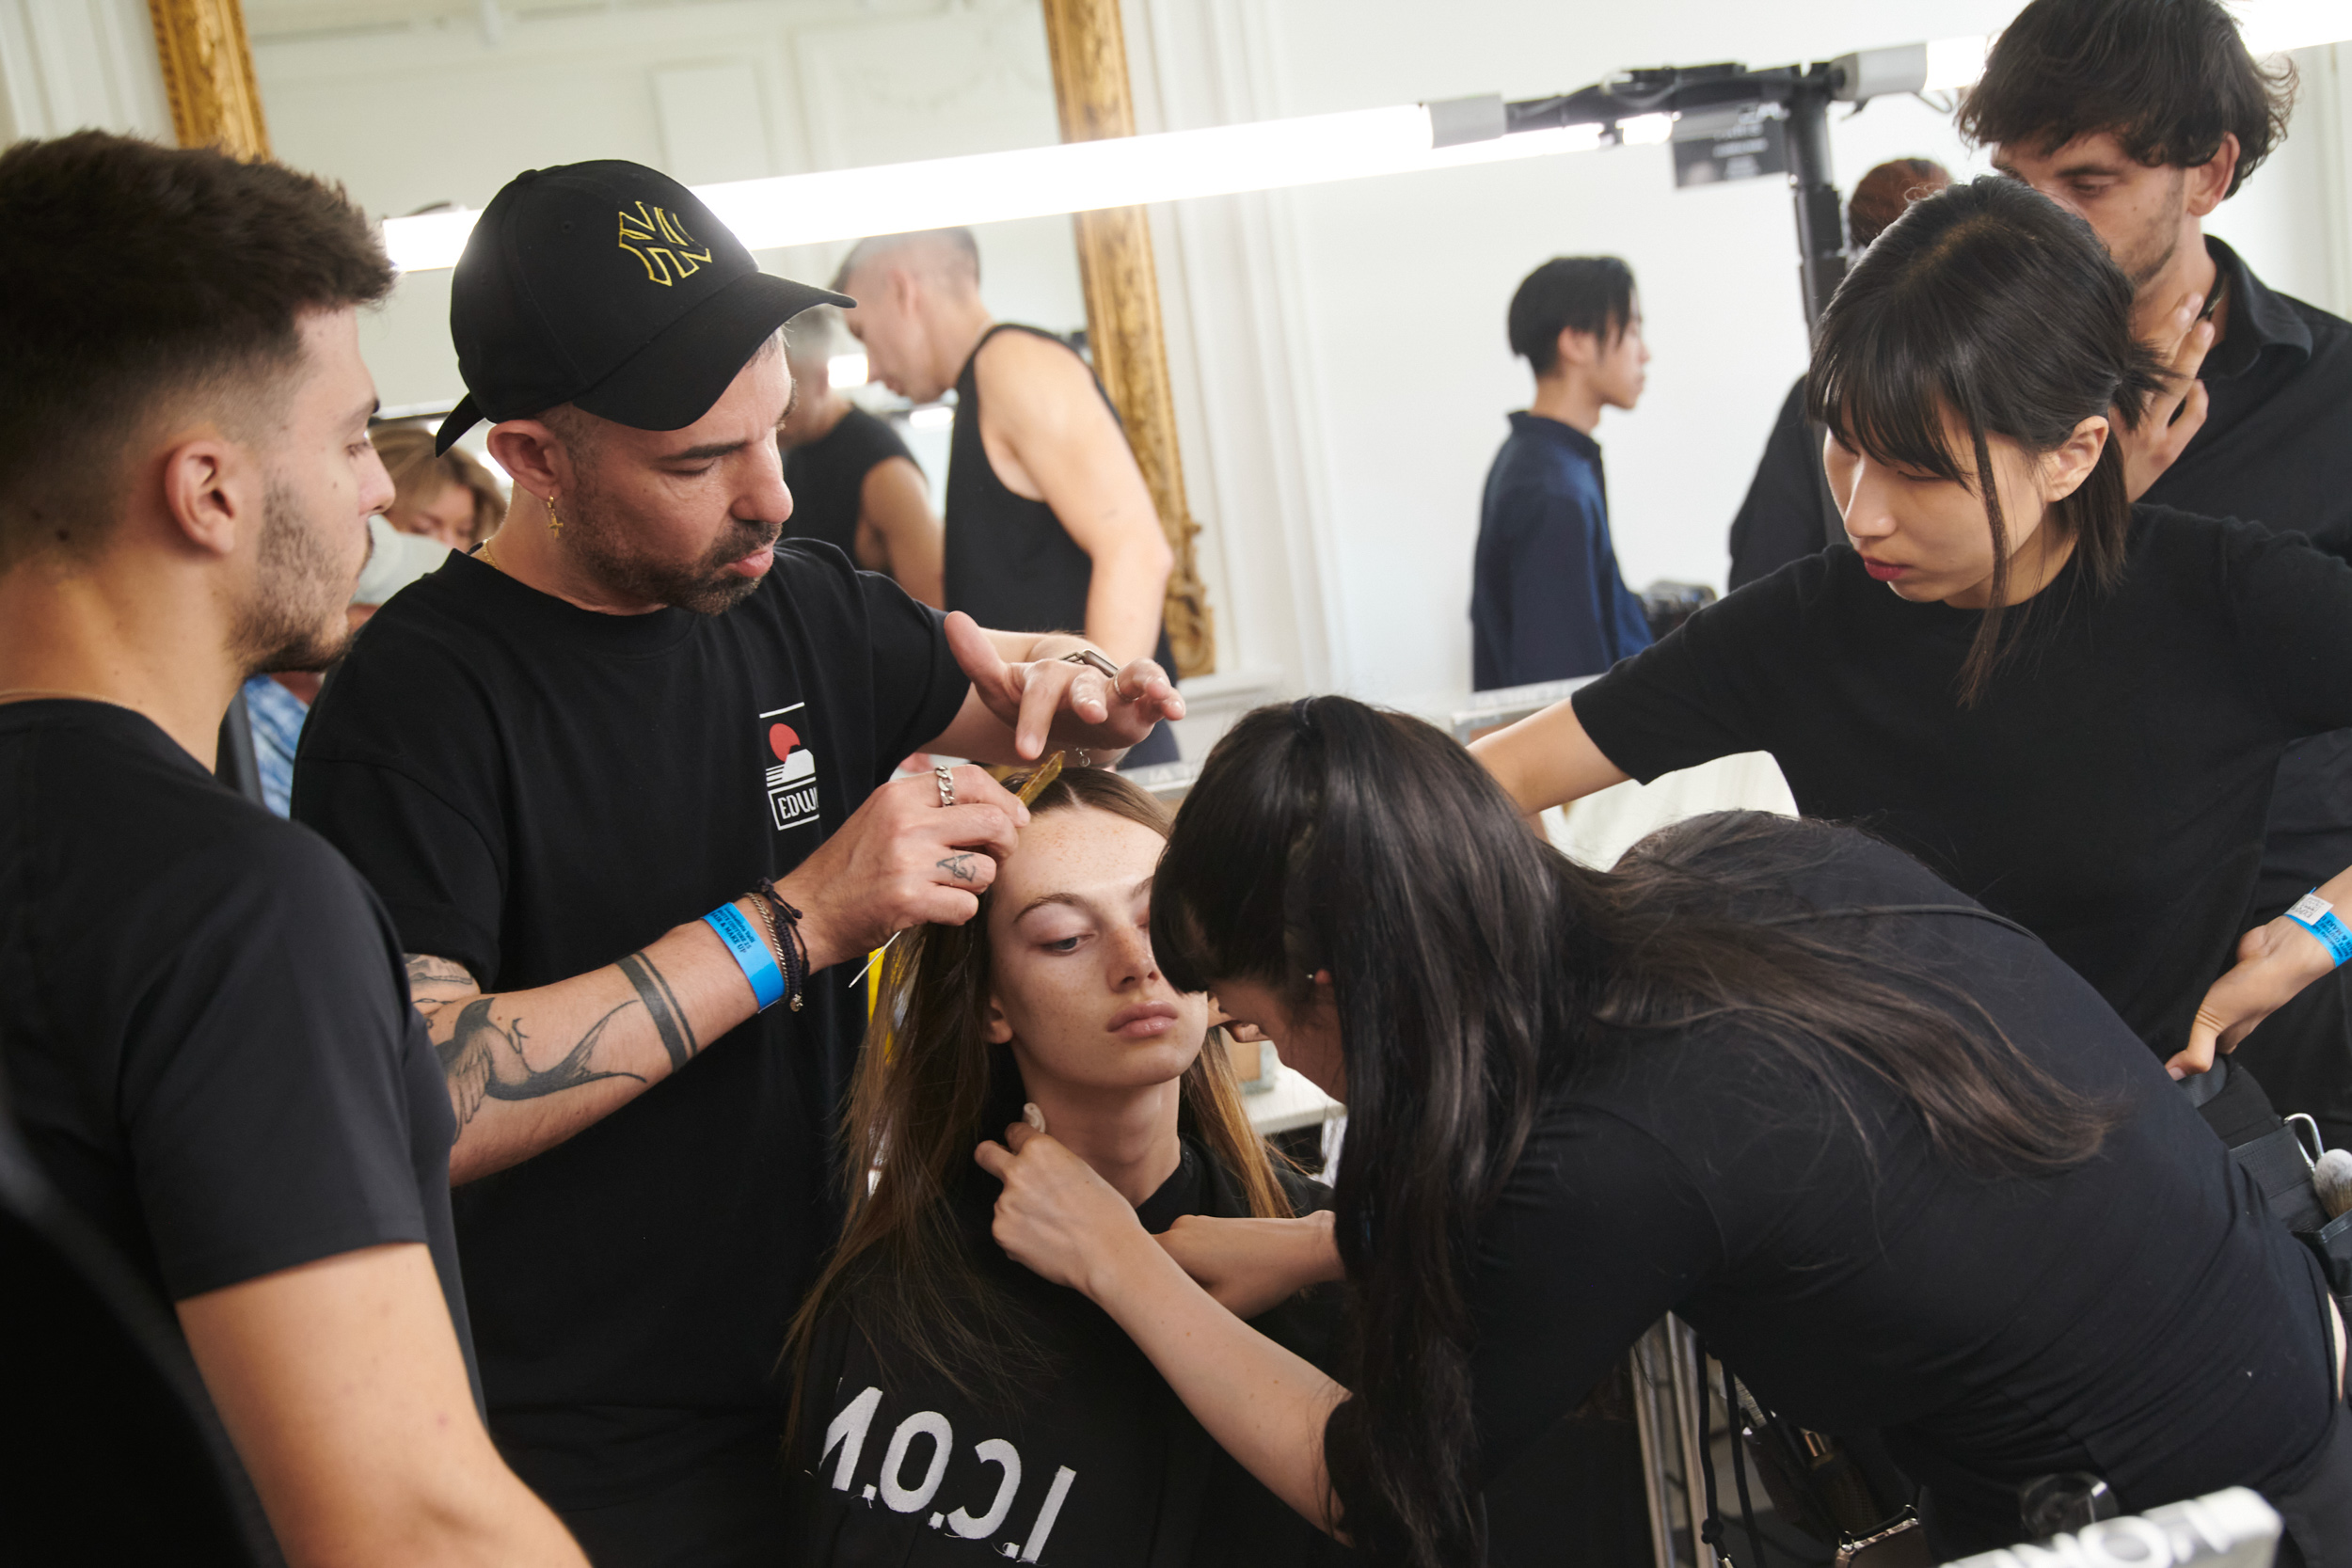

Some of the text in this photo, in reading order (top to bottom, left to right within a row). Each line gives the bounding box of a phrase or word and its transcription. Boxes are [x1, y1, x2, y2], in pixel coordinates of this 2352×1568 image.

[618, 200, 712, 287] NY
[727, 920, 747, 942] COUTURE
[744, 930, 755, 942] Valli
[2319, 923, 2341, 943] COUTURE
[2327, 920, 2344, 936] MAKE
[724, 927, 740, 944] MAKE
[737, 943, 747, 953] UP
